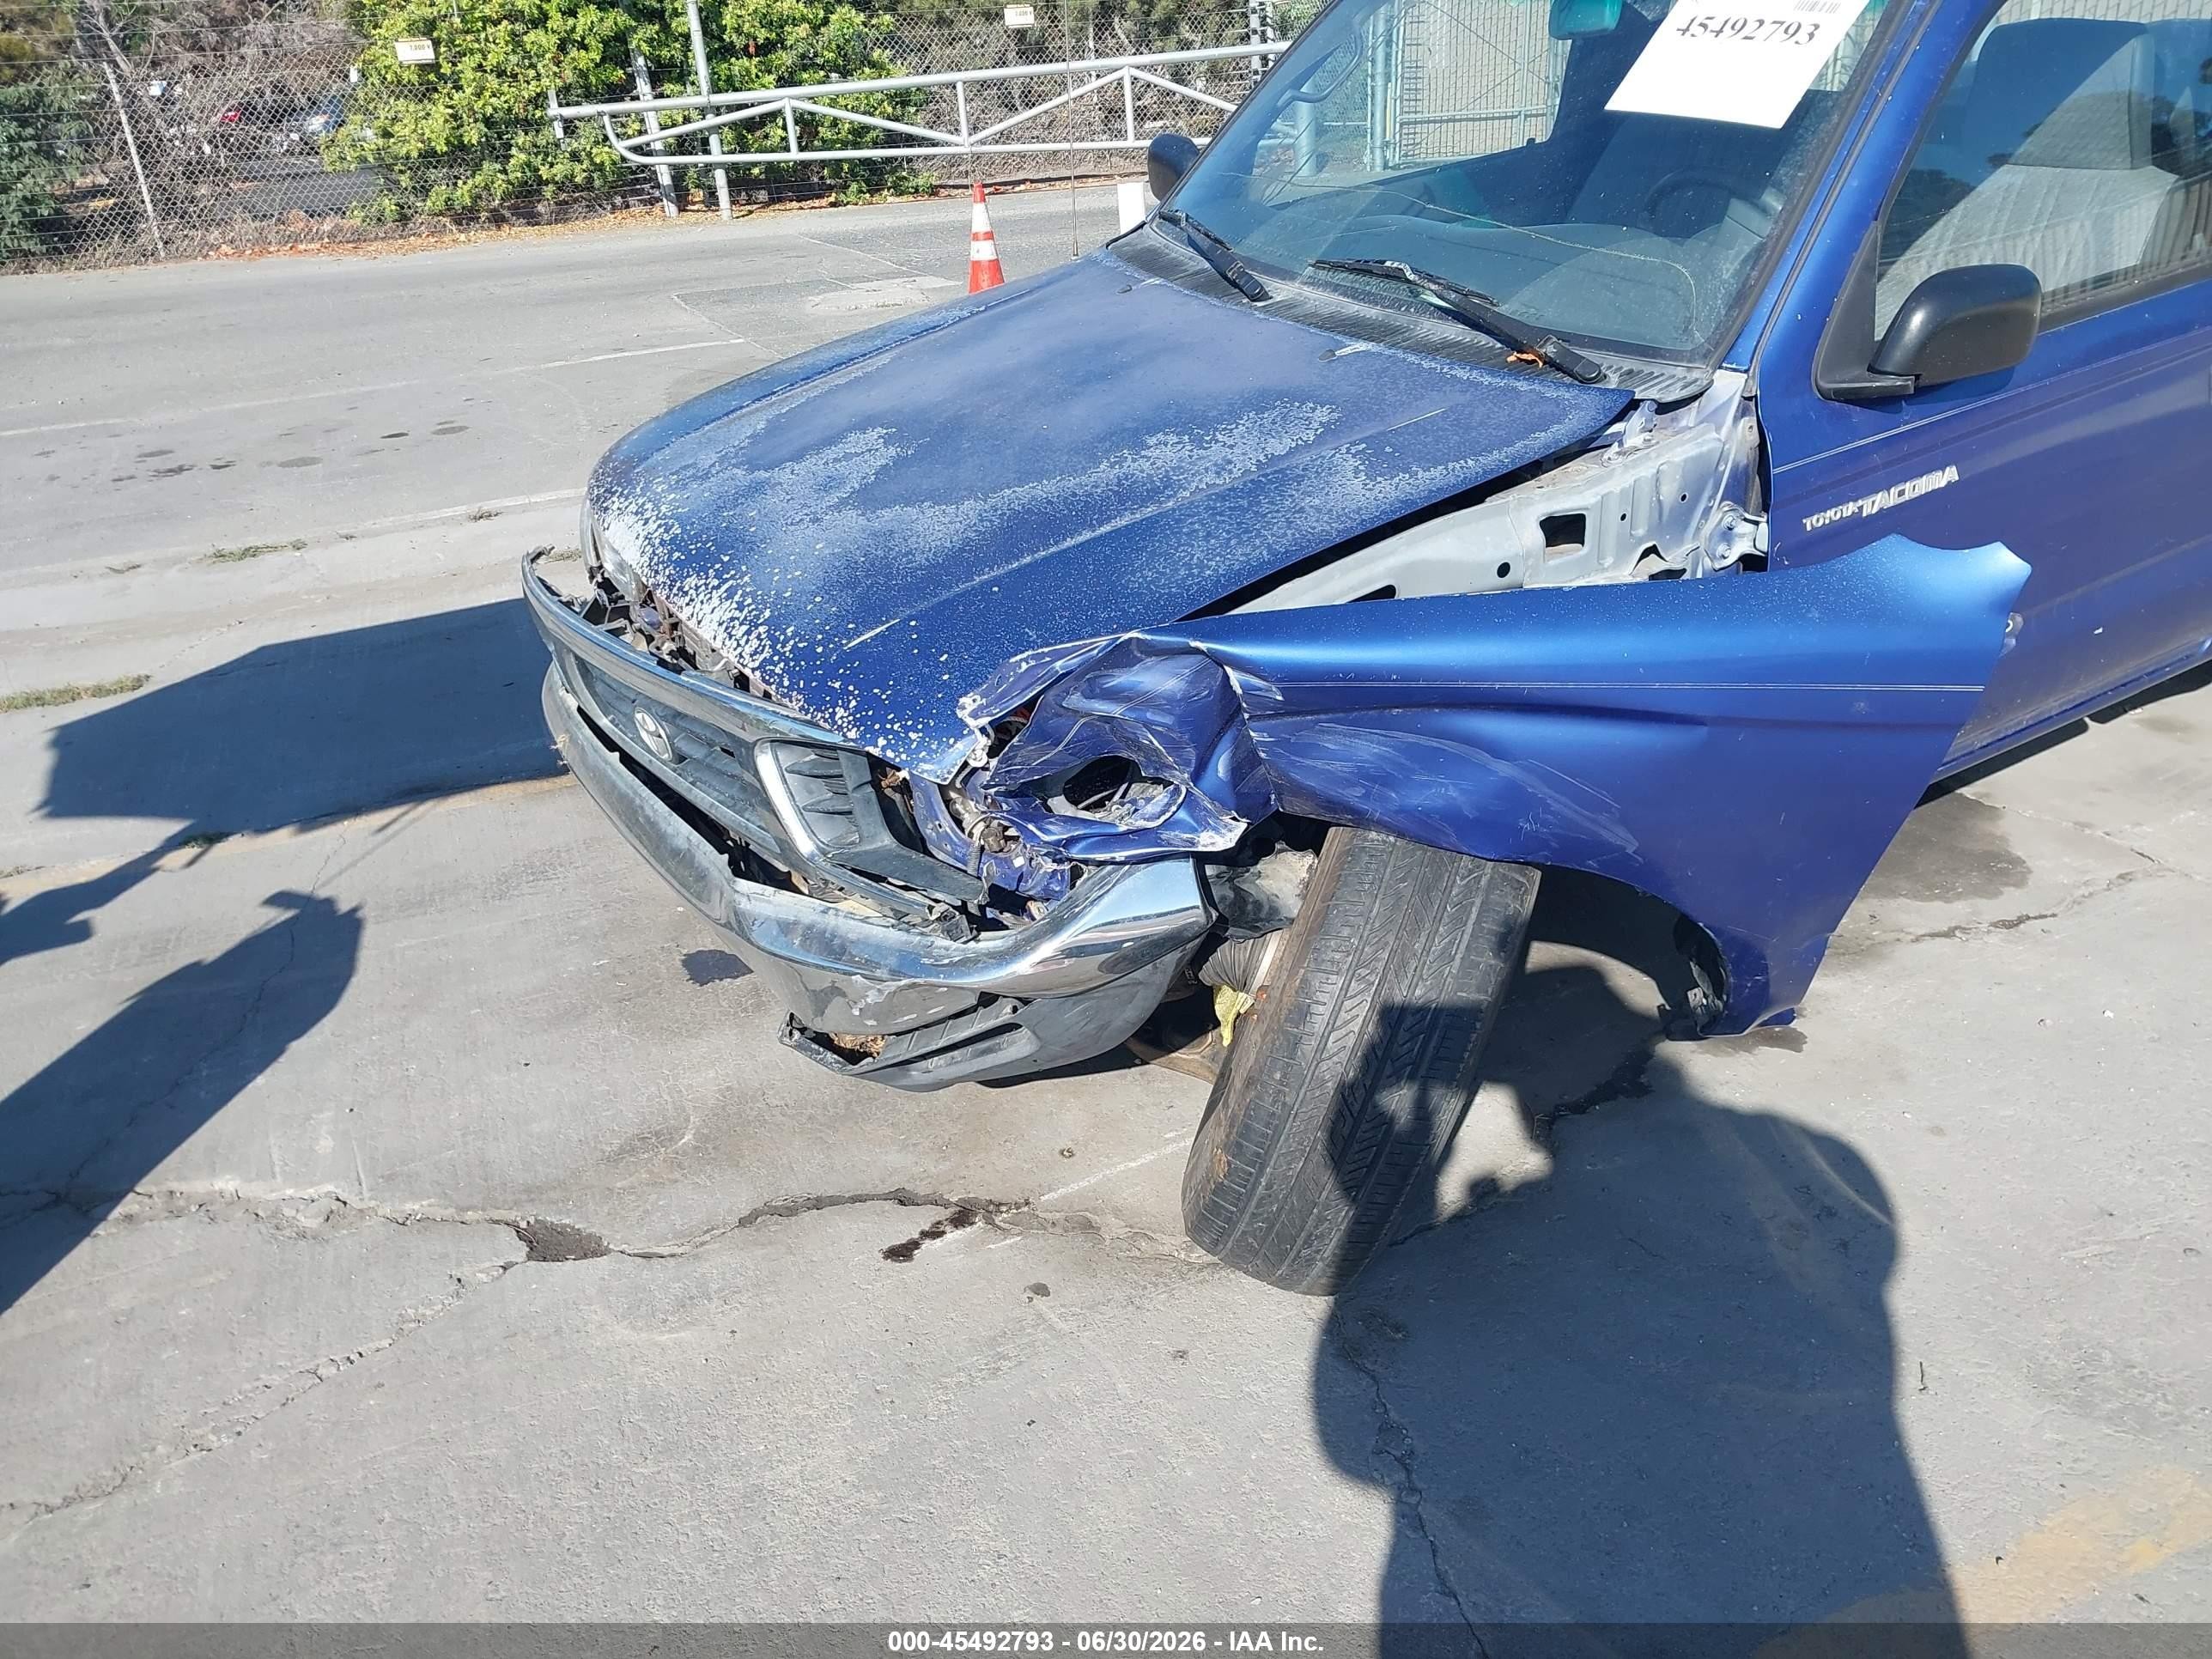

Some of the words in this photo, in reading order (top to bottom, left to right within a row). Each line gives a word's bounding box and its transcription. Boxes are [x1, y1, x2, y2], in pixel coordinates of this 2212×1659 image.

[1676, 15, 1820, 45] 45492793
[1802, 500, 1859, 532] TOYOTA
[1857, 464, 1960, 518] TACOMA
